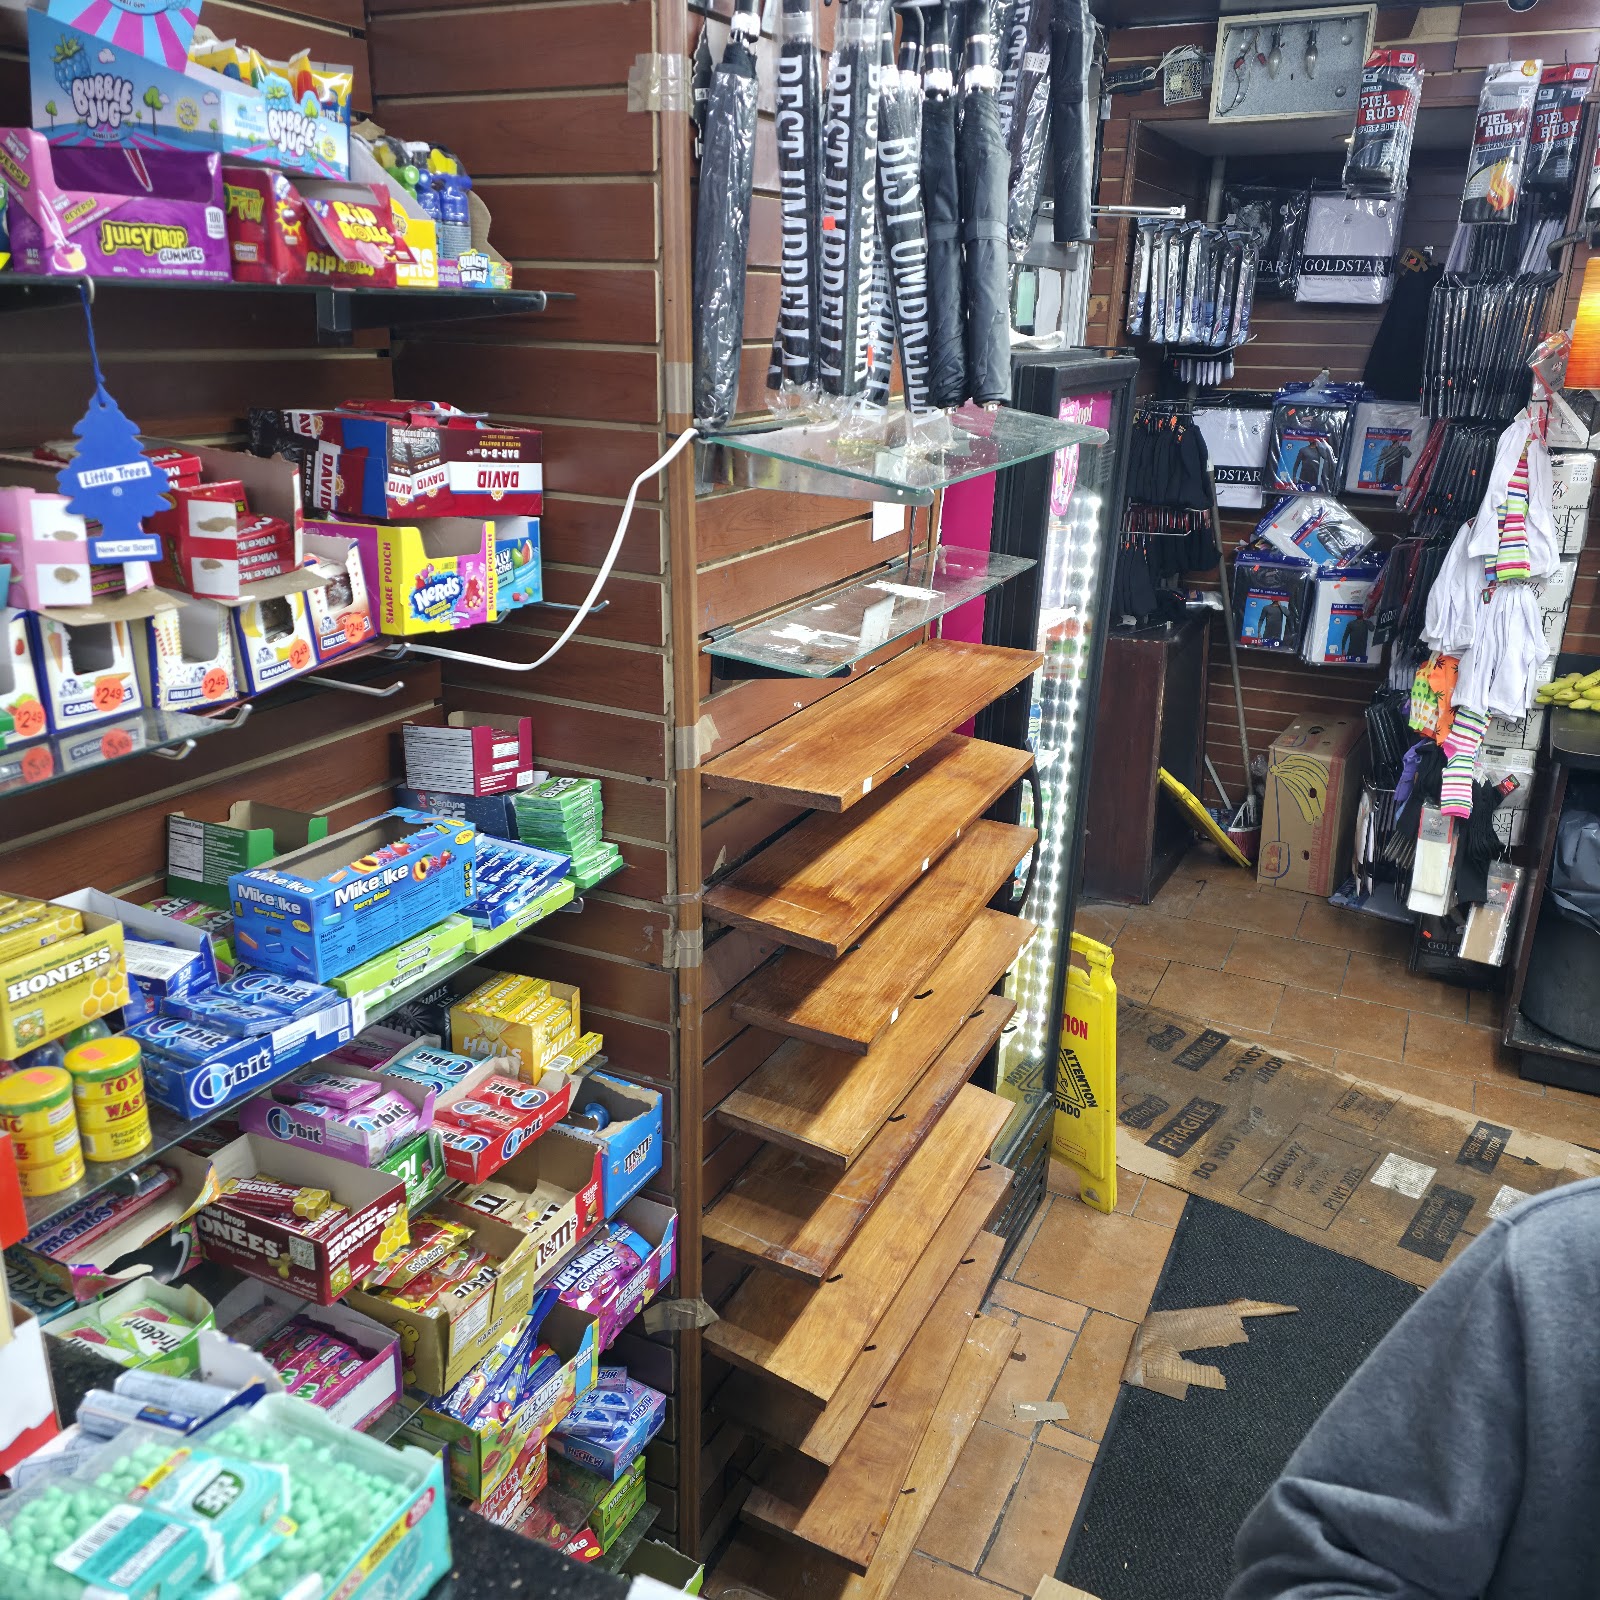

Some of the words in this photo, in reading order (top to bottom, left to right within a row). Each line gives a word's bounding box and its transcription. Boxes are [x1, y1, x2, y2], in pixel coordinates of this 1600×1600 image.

[72, 72, 133, 115] BUBBLE
[1360, 94, 1391, 109] PIEL
[87, 99, 120, 128] JUG
[1365, 105, 1405, 121] RUBY
[1479, 112, 1509, 126] PIEL
[1536, 112, 1564, 126] PIEL
[267, 108, 317, 145] BUBBLE
[1485, 122, 1524, 138] RUBY
[1541, 120, 1579, 139] RUBY
[279, 131, 305, 156] JUG
[64, 198, 97, 222] REVERSE
[103, 224, 157, 254] JUICY
[156, 230, 187, 249] DROP
[160, 249, 203, 263] GUMMIES
[460, 256, 488, 270] QUICK
[1304, 259, 1385, 275] GOLDSTAR
[461, 269, 488, 284] BLAST
[481, 448, 520, 459] BAR-B-Q
[83, 469, 115, 486] Little
[116, 466, 147, 480] Trees
[320, 453, 334, 512] DAVID
[416, 471, 445, 490] DAVID
[477, 470, 520, 489] DAVID
[97, 545, 116, 553] New
[116, 544, 131, 552] Car
[132, 543, 155, 551] Scent
[249, 535, 276, 549] Mike
[250, 550, 278, 565] Mike
[384, 541, 393, 583] POUCH
[254, 565, 281, 578] Mike
[385, 584, 394, 624] SHARE
[323, 637, 335, 647] RED
[170, 690, 192, 700] VANILLA
[429, 796, 466, 810] Dentyne
[245, 870, 284, 887] Mike
[286, 880, 315, 894] Ike
[334, 876, 379, 907] Mike
[383, 863, 409, 884] Ike
[238, 884, 276, 906] Mike
[278, 896, 301, 915] Ike
[254, 906, 270, 917] Berry
[353, 897, 373, 912] Berry
[373, 888, 391, 902] Blast
[320, 925, 345, 940] Nutrition
[7, 945, 111, 1004] HONEES
[230, 973, 312, 1001] Orbit
[495, 979, 522, 1000] HALLS
[527, 1000, 552, 1022] HALLS
[146, 1016, 229, 1049] Orbit
[464, 1036, 522, 1061] HALLS
[539, 1024, 577, 1069] HALLS
[1238, 1045, 1268, 1065] NOT
[413, 1050, 476, 1077] Orbit
[190, 1051, 272, 1109] Orbit
[1063, 1047, 1099, 1109] ATTENTION
[484, 1081, 550, 1110] Orbit
[451, 1099, 519, 1125] Orbit
[265, 1106, 324, 1145] Orbit
[500, 1110, 545, 1161] Orbit
[1157, 1104, 1217, 1151] FRAGILE
[1192, 1161, 1218, 1180] DO
[1214, 1134, 1242, 1160] NOT
[1259, 1140, 1307, 1188] January
[236, 1182, 300, 1197] HONEES
[582, 1181, 598, 1202] SHARE
[34, 1199, 115, 1254] mentos
[223, 1212, 246, 1229] Drops
[326, 1231, 344, 1250] Honey
[343, 1219, 361, 1237] Filled
[360, 1206, 379, 1224] Drops
[328, 1201, 398, 1264] HONEES
[407, 1244, 445, 1273] Goldbears
[577, 1256, 622, 1292] GUMMIES
[122, 1317, 182, 1354] Trident
[476, 1317, 504, 1346] HARIBO
[567, 1537, 589, 1554] Ike
